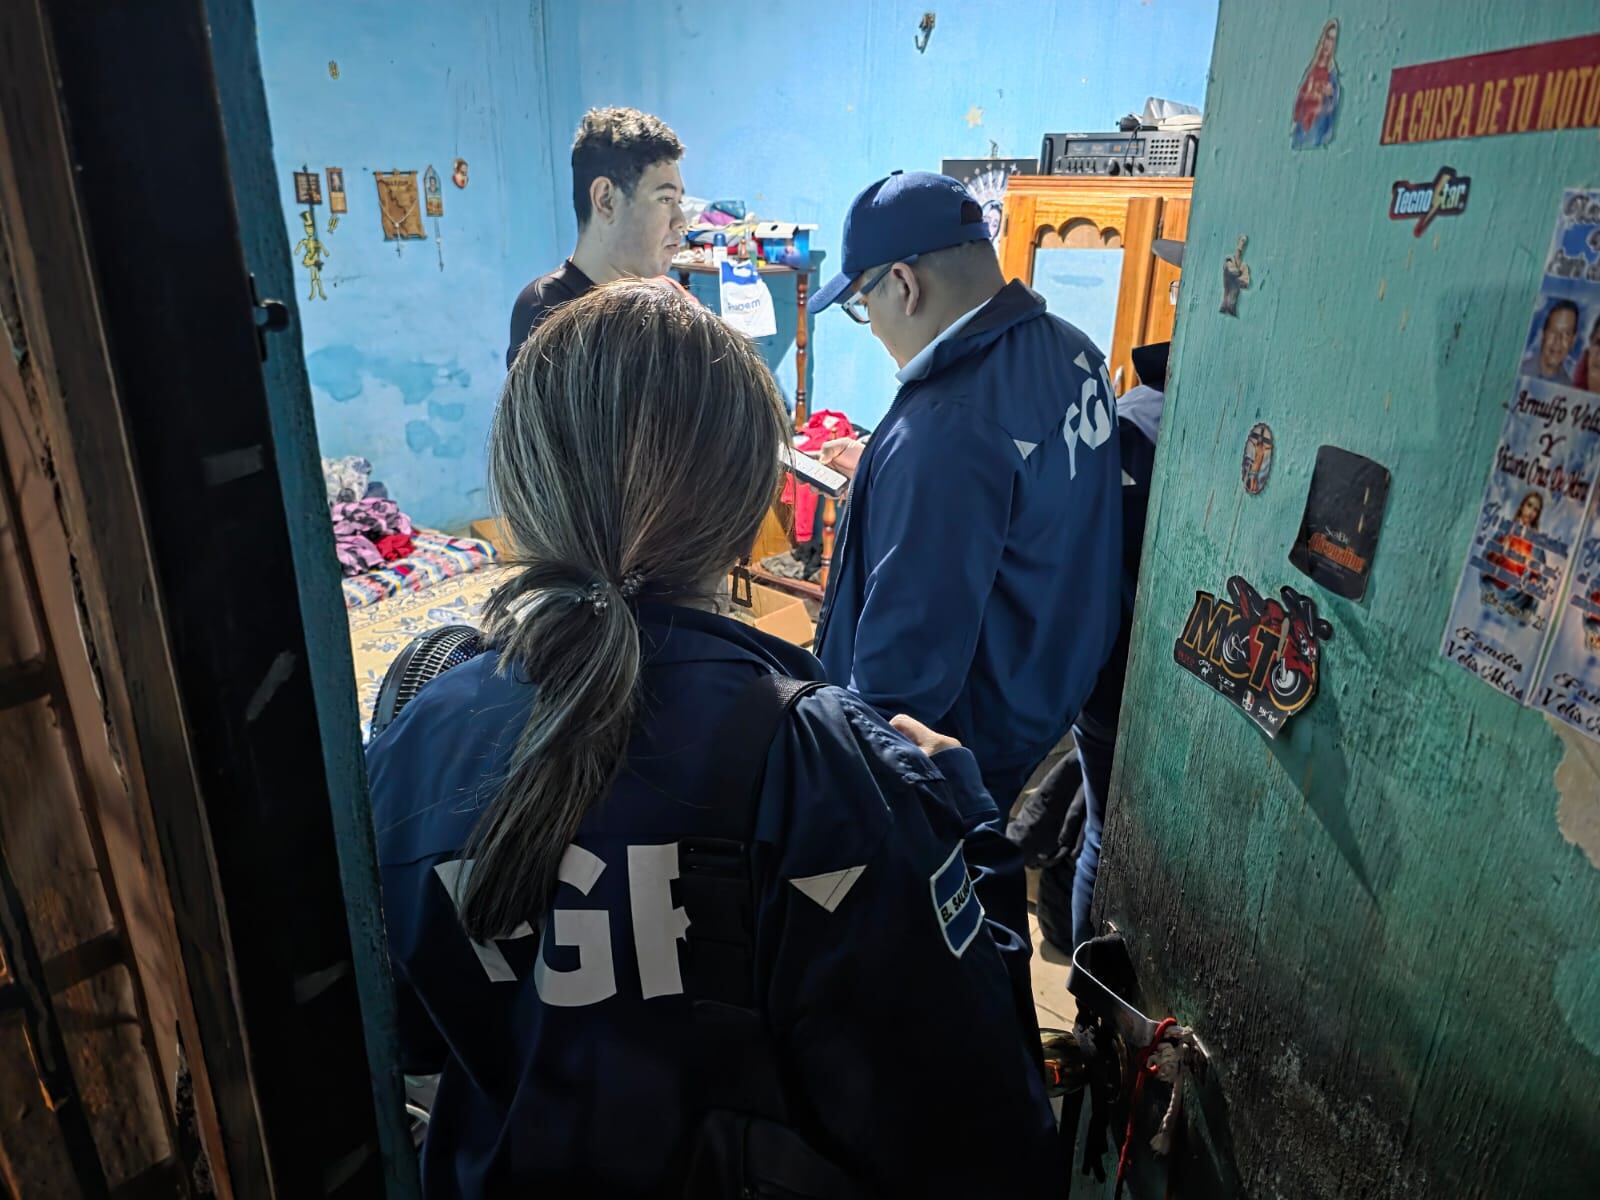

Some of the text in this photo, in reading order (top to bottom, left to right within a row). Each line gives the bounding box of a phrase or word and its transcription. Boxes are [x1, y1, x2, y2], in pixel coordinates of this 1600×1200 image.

[1385, 92, 1407, 143] LA
[1408, 85, 1475, 142] CHISPA
[1475, 81, 1507, 135] DE
[1507, 73, 1539, 133] TU
[1512, 389, 1567, 428] Arnulfo
[1456, 627, 1523, 673] Familia
